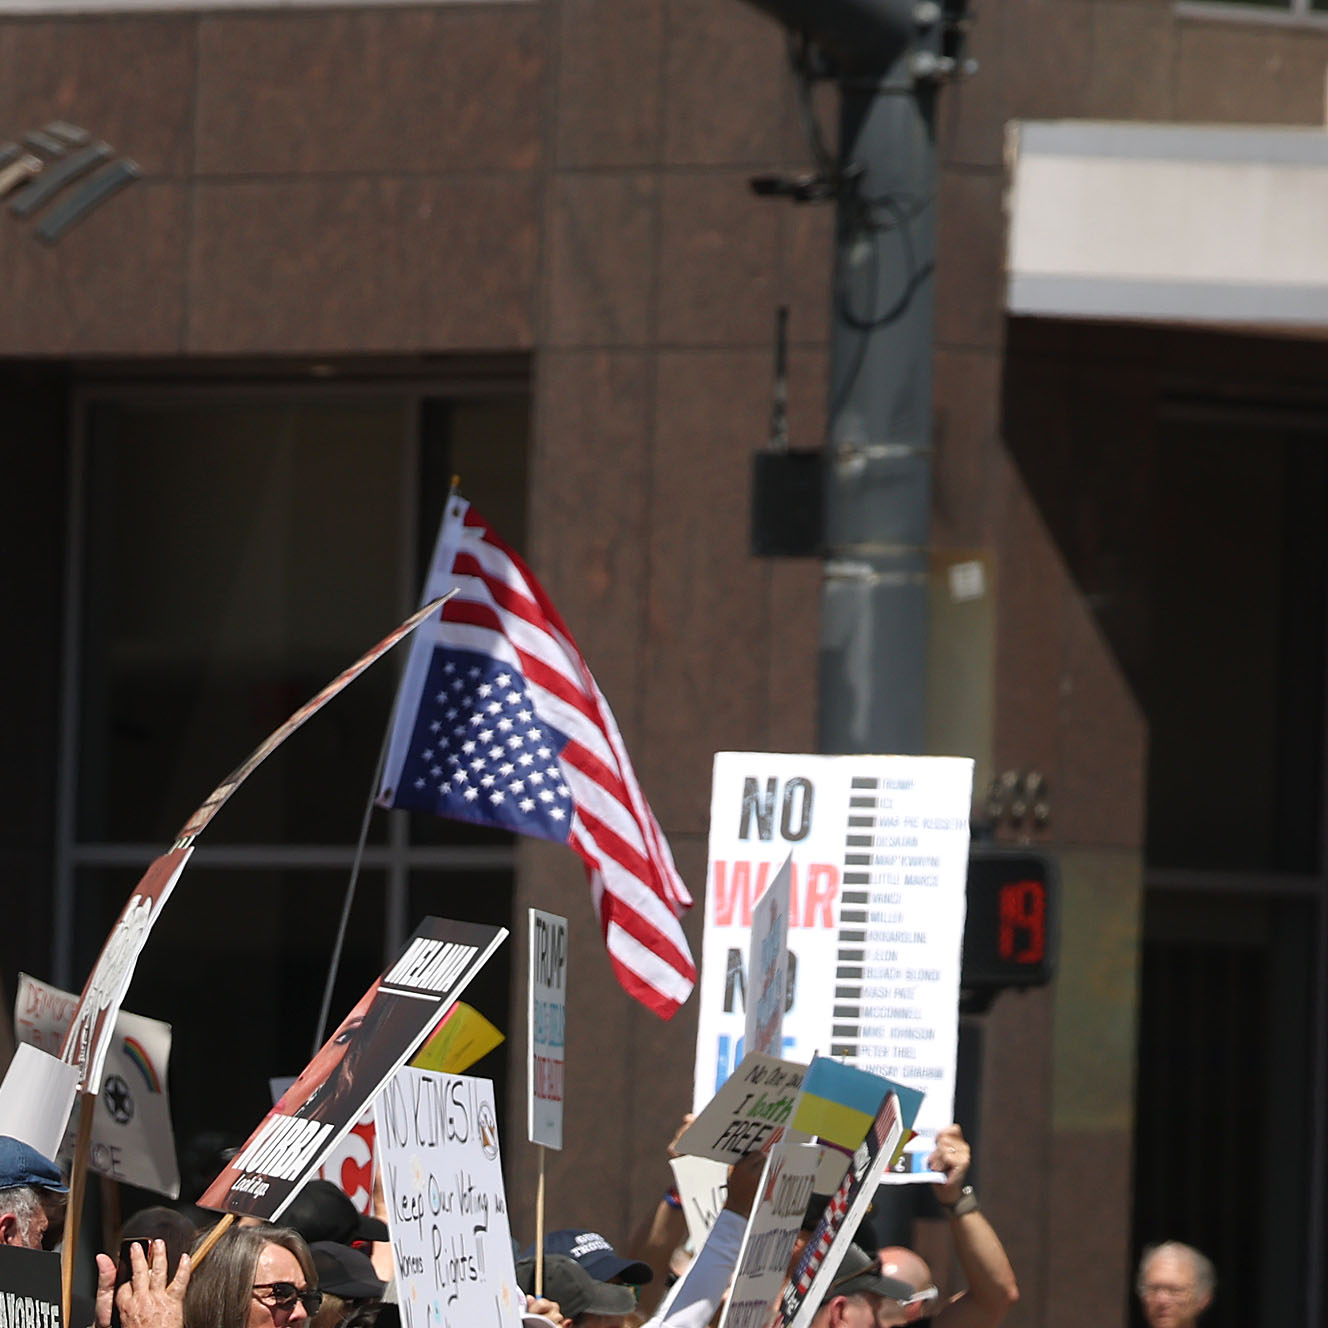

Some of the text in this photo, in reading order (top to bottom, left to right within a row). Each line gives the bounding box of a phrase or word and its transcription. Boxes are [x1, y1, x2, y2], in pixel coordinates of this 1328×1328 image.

[738, 776, 815, 841] NO
[713, 860, 839, 928] WR
[744, 1064, 762, 1085] No
[713, 1120, 774, 1156] FREE
[388, 1162, 425, 1241] Keep
[428, 1172, 455, 1217] Our
